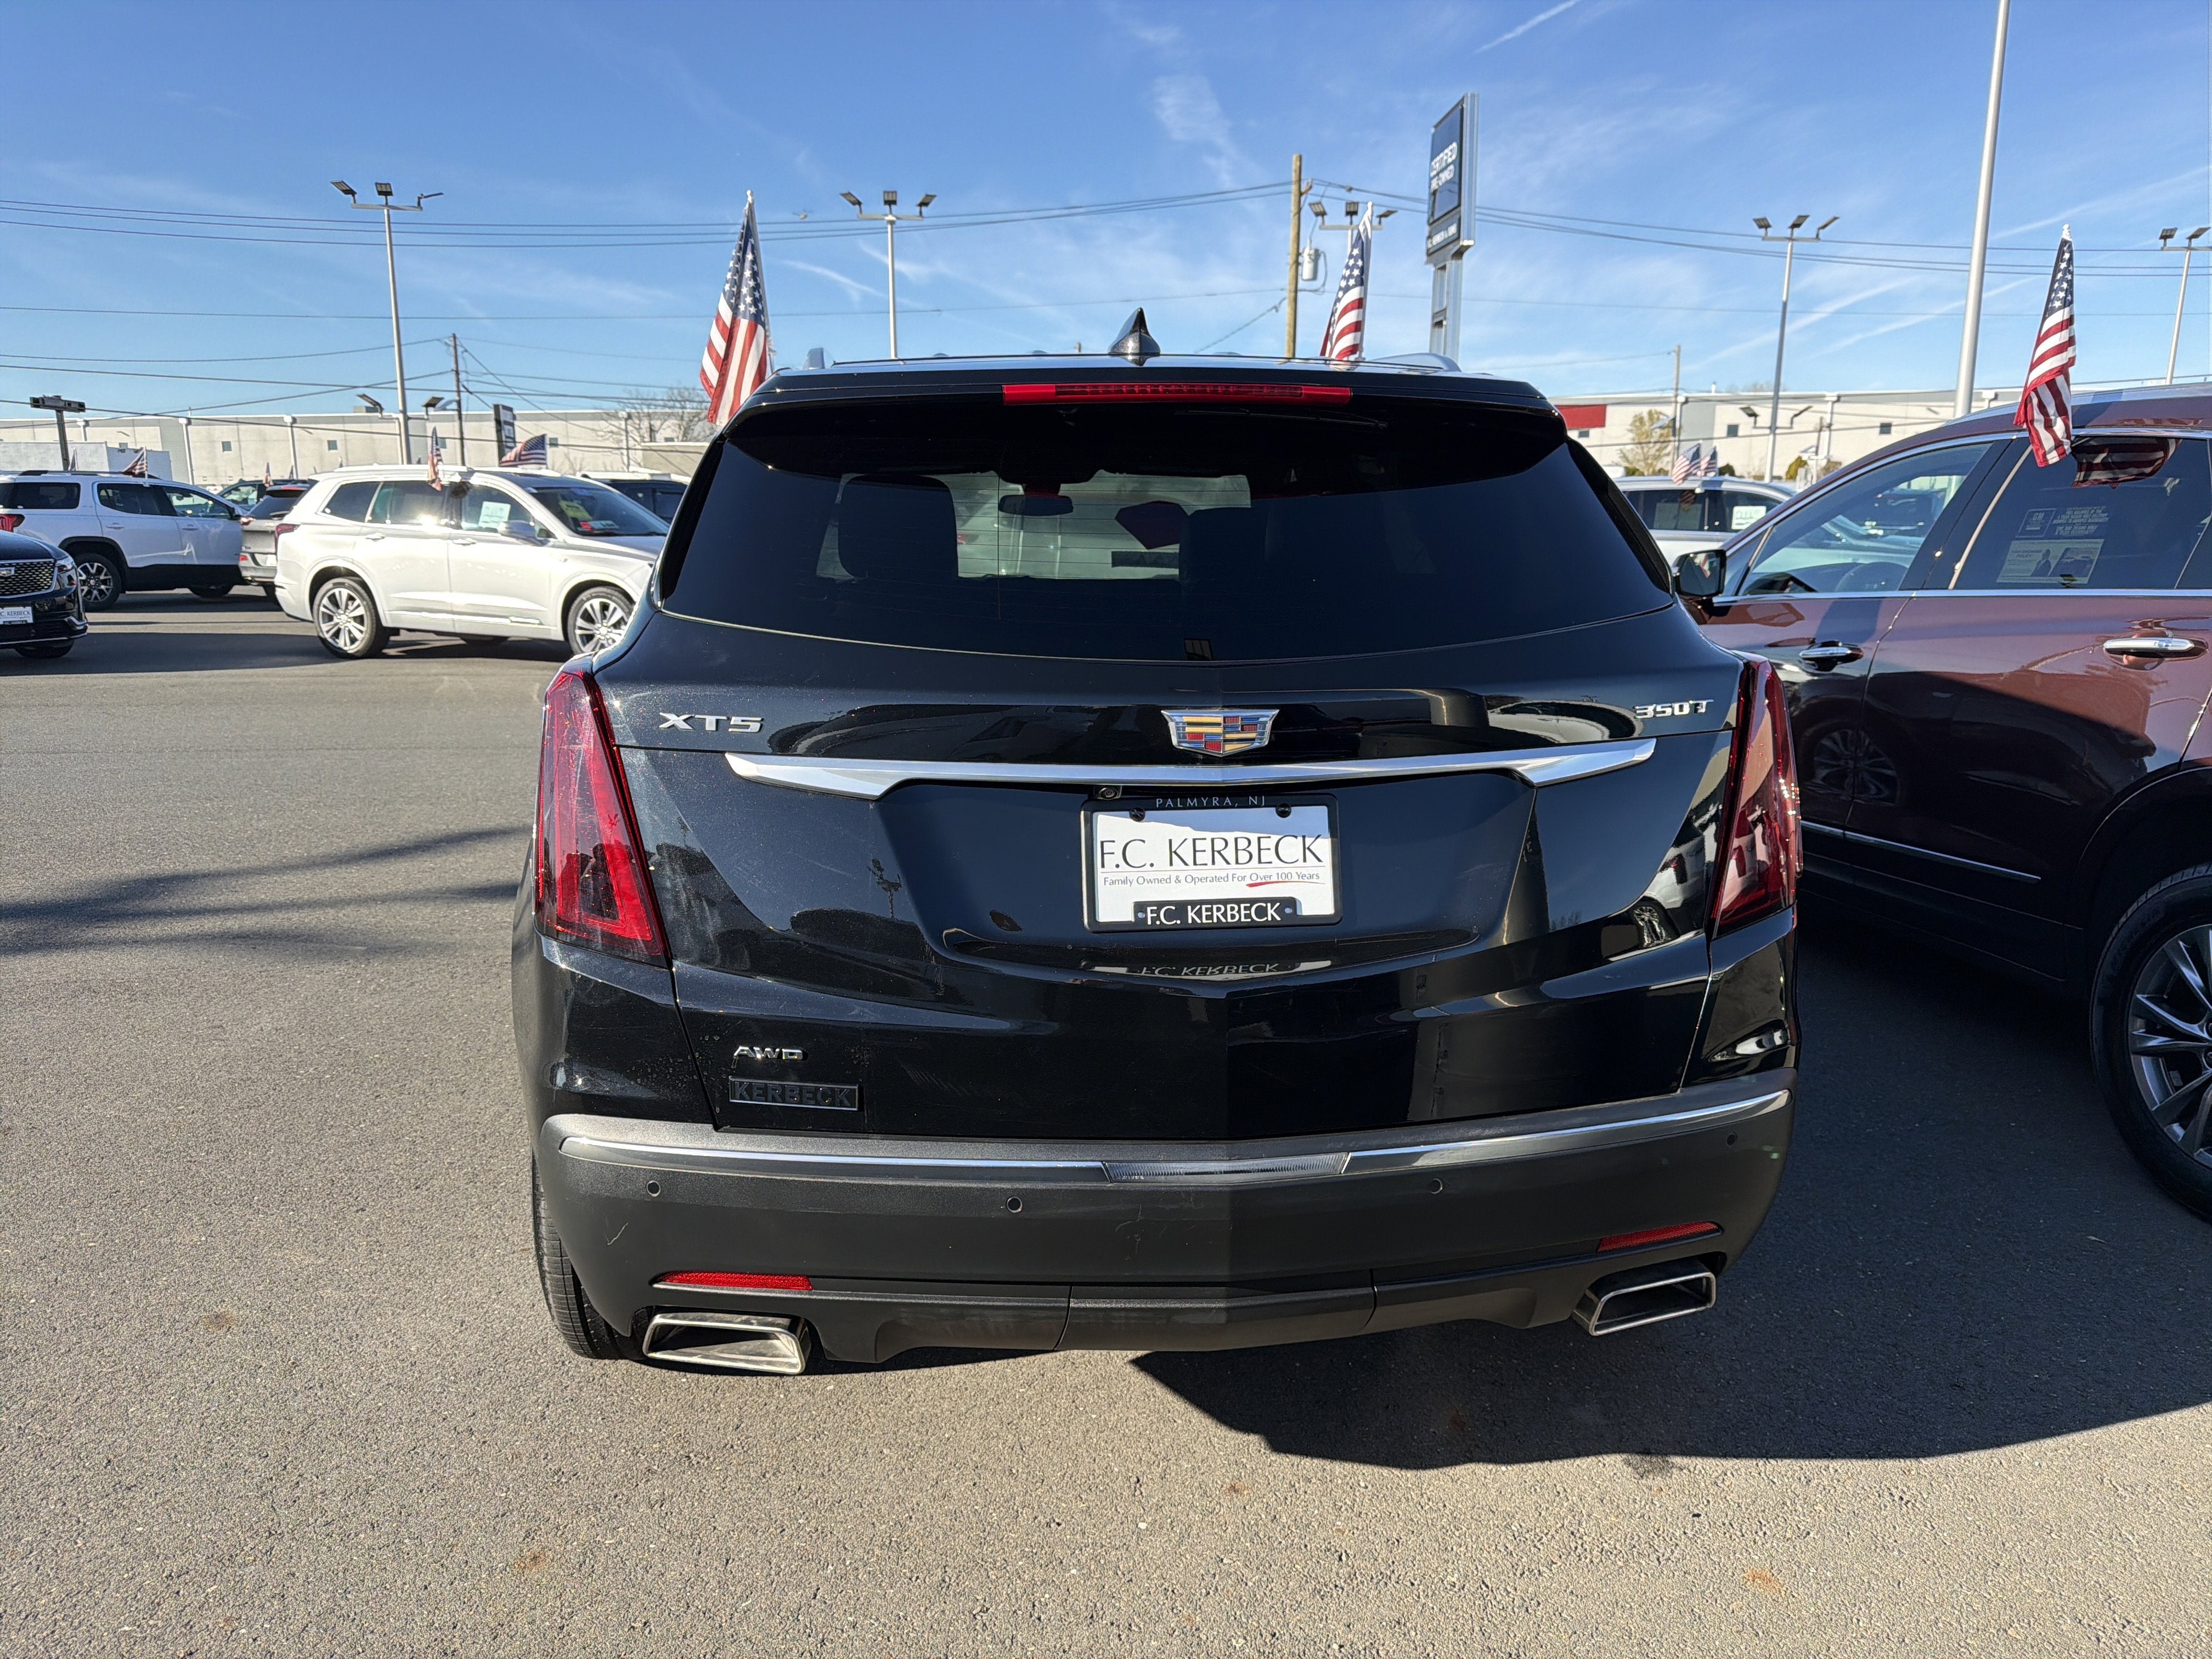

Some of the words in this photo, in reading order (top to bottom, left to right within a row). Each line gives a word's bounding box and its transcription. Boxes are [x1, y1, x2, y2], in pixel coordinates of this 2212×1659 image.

[1633, 698, 1714, 719] 350T
[658, 712, 764, 733] XT5
[1155, 795, 1238, 808] PALMYRA,
[1249, 795, 1266, 806] NJ
[1100, 839, 1155, 869] F.C.
[1169, 834, 1323, 867] KERBECK
[1103, 875, 1134, 888] Family
[1136, 874, 1172, 885] Owned
[1174, 874, 1182, 884] &
[1184, 873, 1229, 885] Operated
[1232, 872, 1248, 882] For
[1249, 872, 1273, 882] Over
[1276, 871, 1293, 881] 100
[1295, 871, 1320, 881] Years
[1146, 906, 1181, 925] F.C.
[1187, 902, 1282, 924] KERBECK
[733, 1046, 804, 1060] AWD
[734, 1081, 851, 1107] KERBECK
